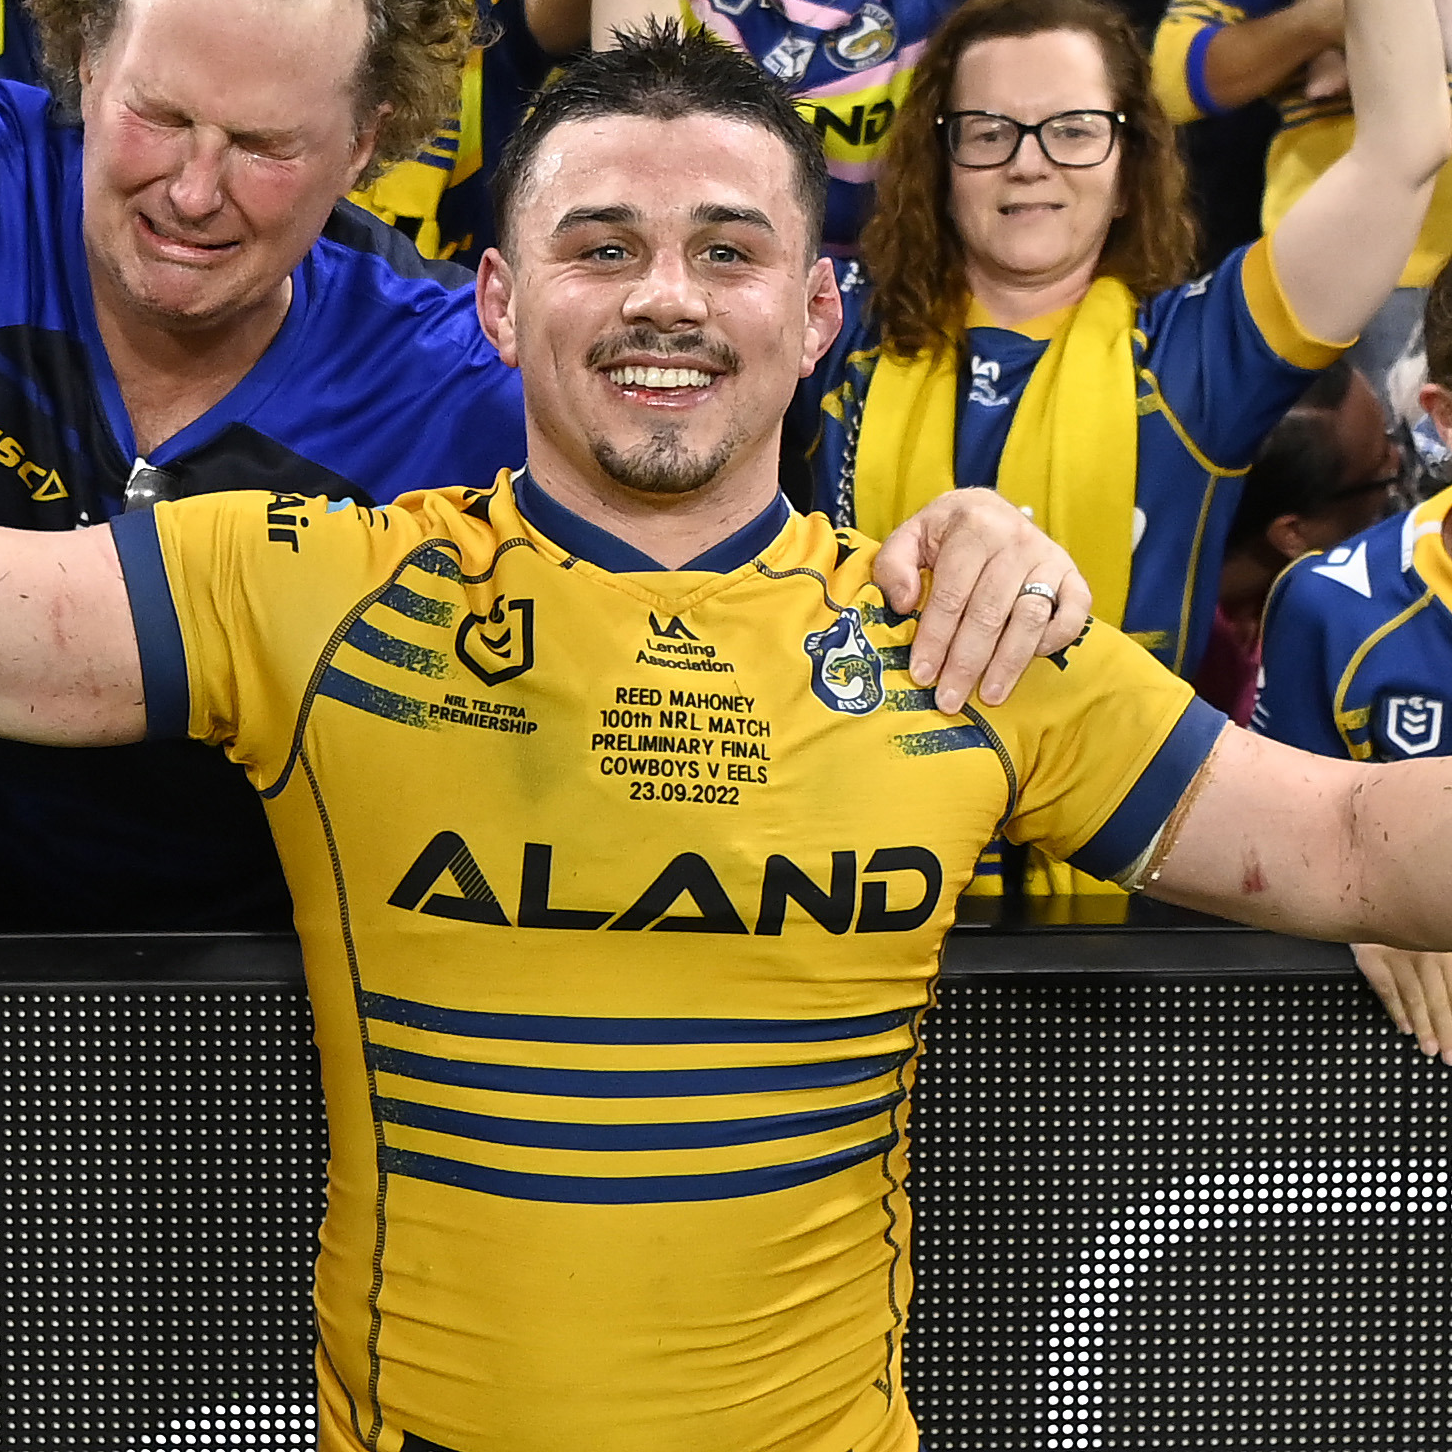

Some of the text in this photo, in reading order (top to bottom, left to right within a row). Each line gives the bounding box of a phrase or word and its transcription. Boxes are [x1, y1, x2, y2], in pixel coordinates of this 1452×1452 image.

[635, 649, 735, 673] Association
[646, 638, 717, 658] Lending
[443, 693, 527, 719] NRL TELSTRA
[615, 686, 756, 714] REED MAHONEY
[836, 696, 868, 710] EELS
[428, 703, 539, 736] PREMIERSHIP
[600, 709, 771, 738] 100th NRL MATCH
[591, 732, 771, 761] PRELIMINARY FINAL
[600, 756, 769, 784] COWBOYS V EELS
[629, 781, 740, 806] 23.09.2022
[386, 829, 944, 937] ALAND
